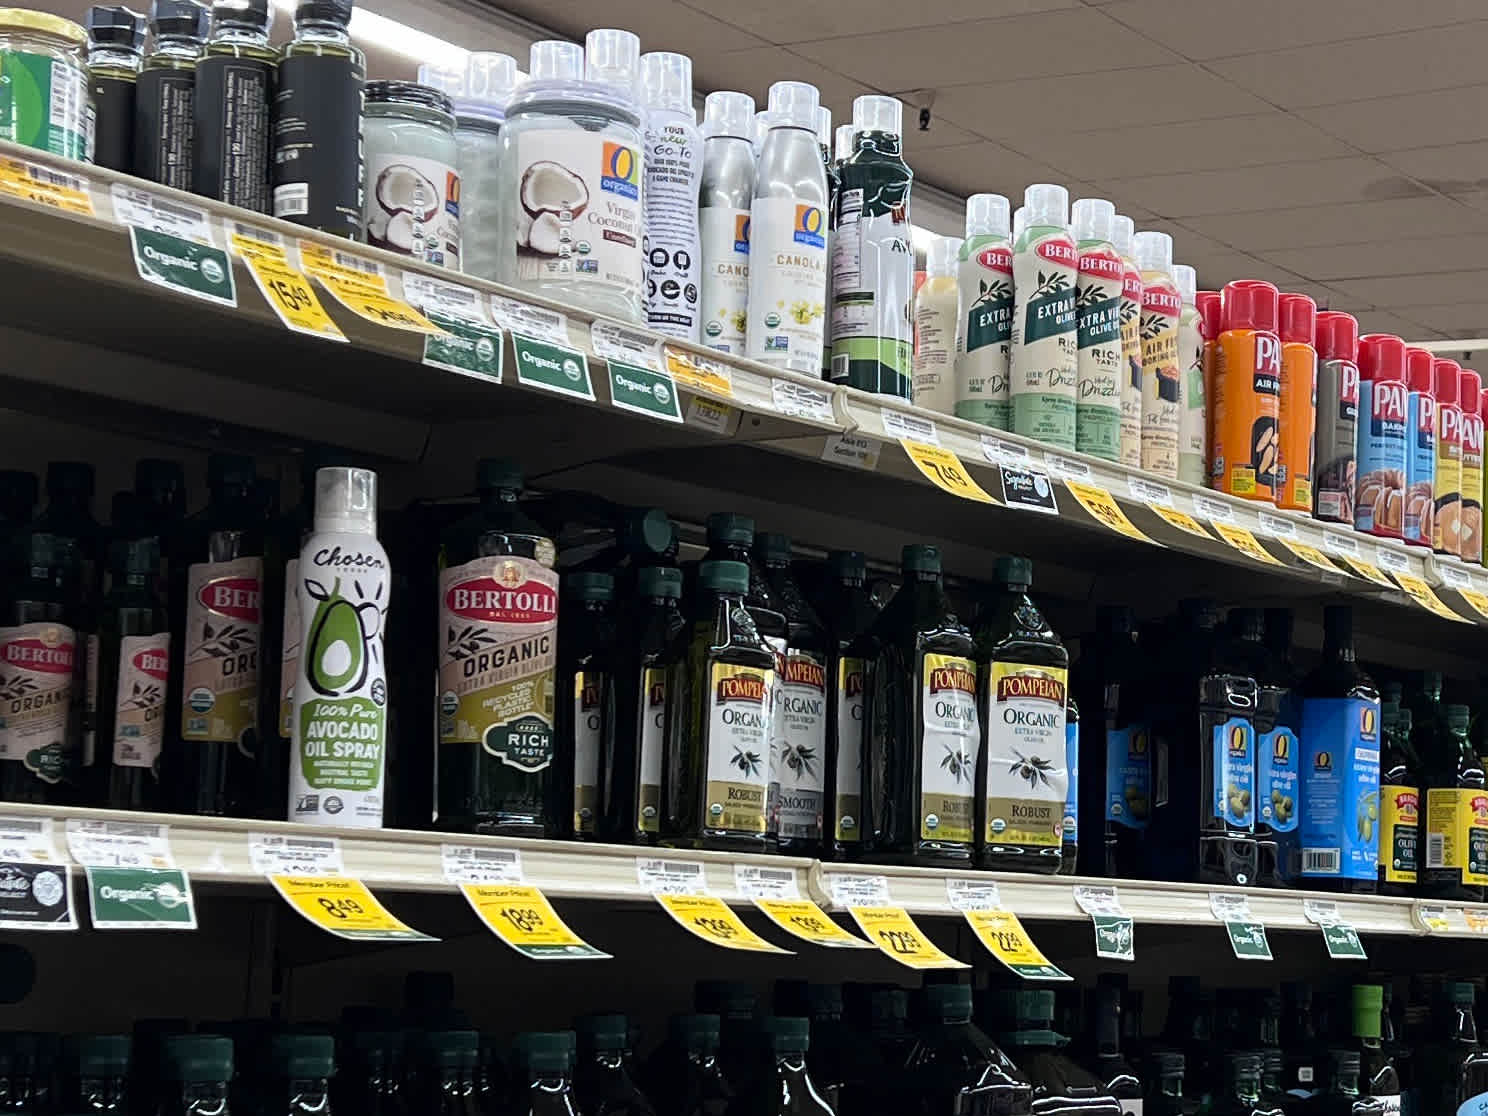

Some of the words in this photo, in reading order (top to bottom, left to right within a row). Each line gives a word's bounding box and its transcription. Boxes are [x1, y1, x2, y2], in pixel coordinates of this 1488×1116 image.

[143, 246, 198, 271] Organic
[268, 279, 312, 312] 1549
[522, 350, 562, 371] Organic
[615, 374, 652, 395] Organic
[313, 546, 385, 569] Chosen
[453, 588, 557, 613] BERTOLLI
[463, 635, 550, 679] ORGANIC
[934, 670, 975, 692] POMPEIAN
[1003, 676, 1063, 700] POMPEIAN
[313, 703, 348, 718] 100%
[350, 702, 377, 719] Pure
[1003, 708, 1060, 728] ORGANIC
[307, 720, 378, 740] AVOCADO
[508, 733, 549, 748] RICH
[305, 742, 331, 758] OIL
[333, 741, 380, 760] SPRAY
[514, 748, 545, 758] TASTE
[1012, 804, 1050, 819] ROBUST
[317, 897, 364, 919] 849
